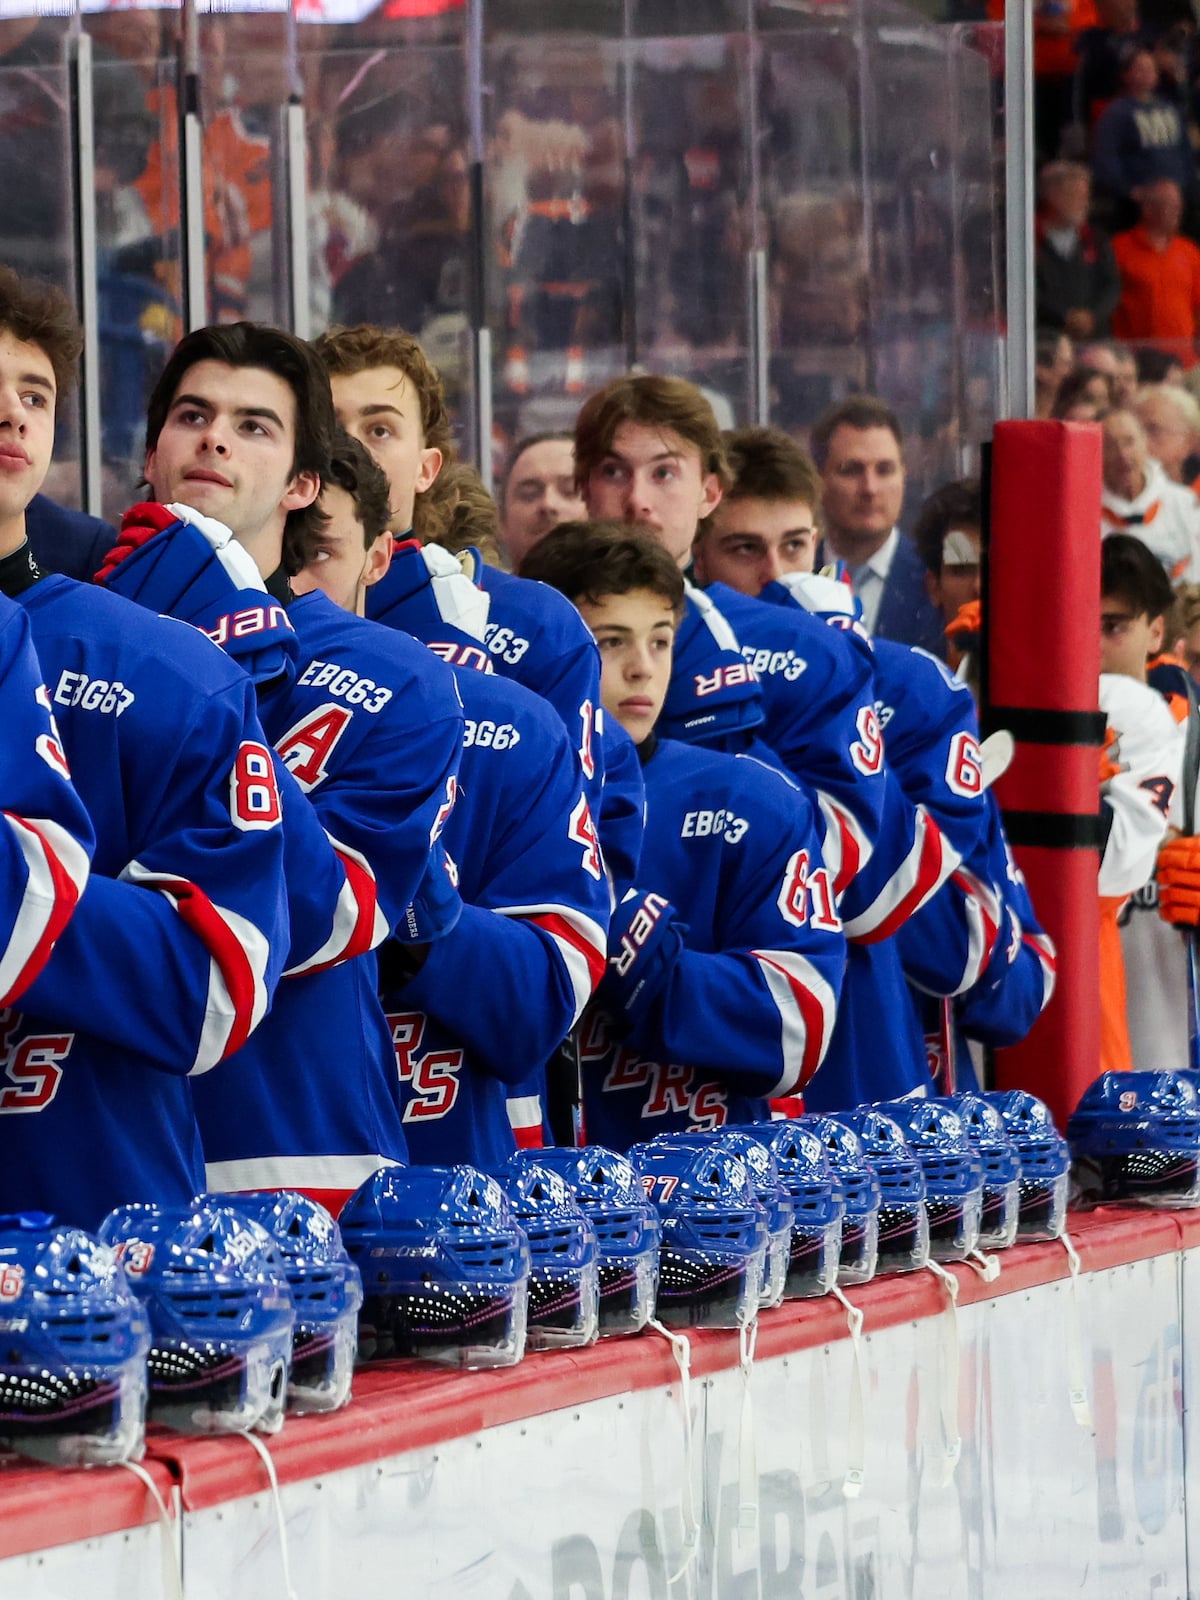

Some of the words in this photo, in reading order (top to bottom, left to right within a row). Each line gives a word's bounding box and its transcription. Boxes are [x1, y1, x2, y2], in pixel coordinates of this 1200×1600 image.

[297, 660, 393, 713] EBG63
[274, 702, 353, 793] A
[850, 706, 884, 777] 9
[230, 741, 283, 832] 8
[1118, 1091, 1138, 1112] 9
